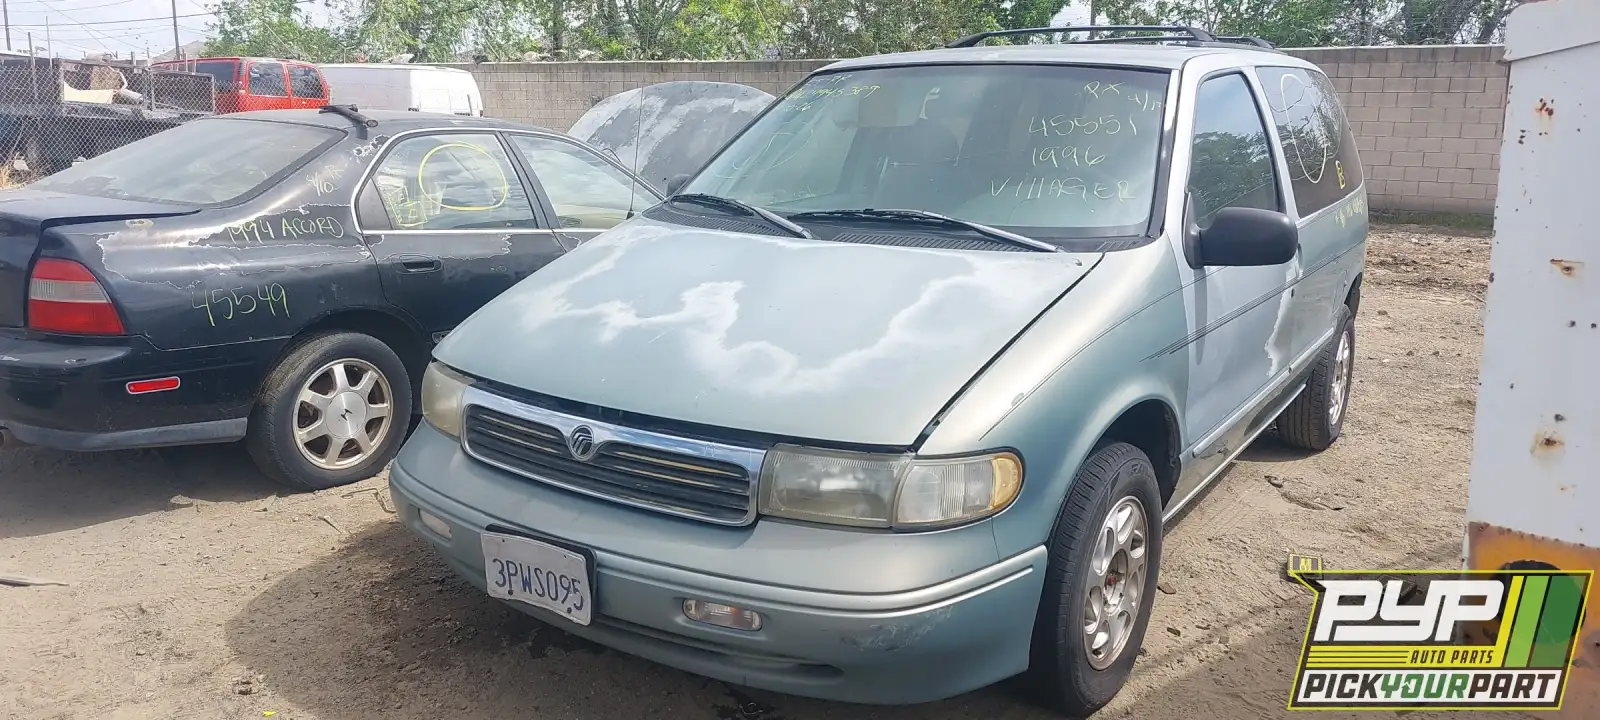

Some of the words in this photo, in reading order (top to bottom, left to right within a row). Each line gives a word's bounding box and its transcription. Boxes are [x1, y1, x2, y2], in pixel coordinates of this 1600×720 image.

[1028, 113, 1138, 137] 45551
[1032, 145, 1106, 168] 1996
[226, 219, 276, 245] 1994
[282, 216, 344, 239] ACCORD
[191, 282, 291, 327] 45549
[492, 557, 585, 611] 3PWS095
